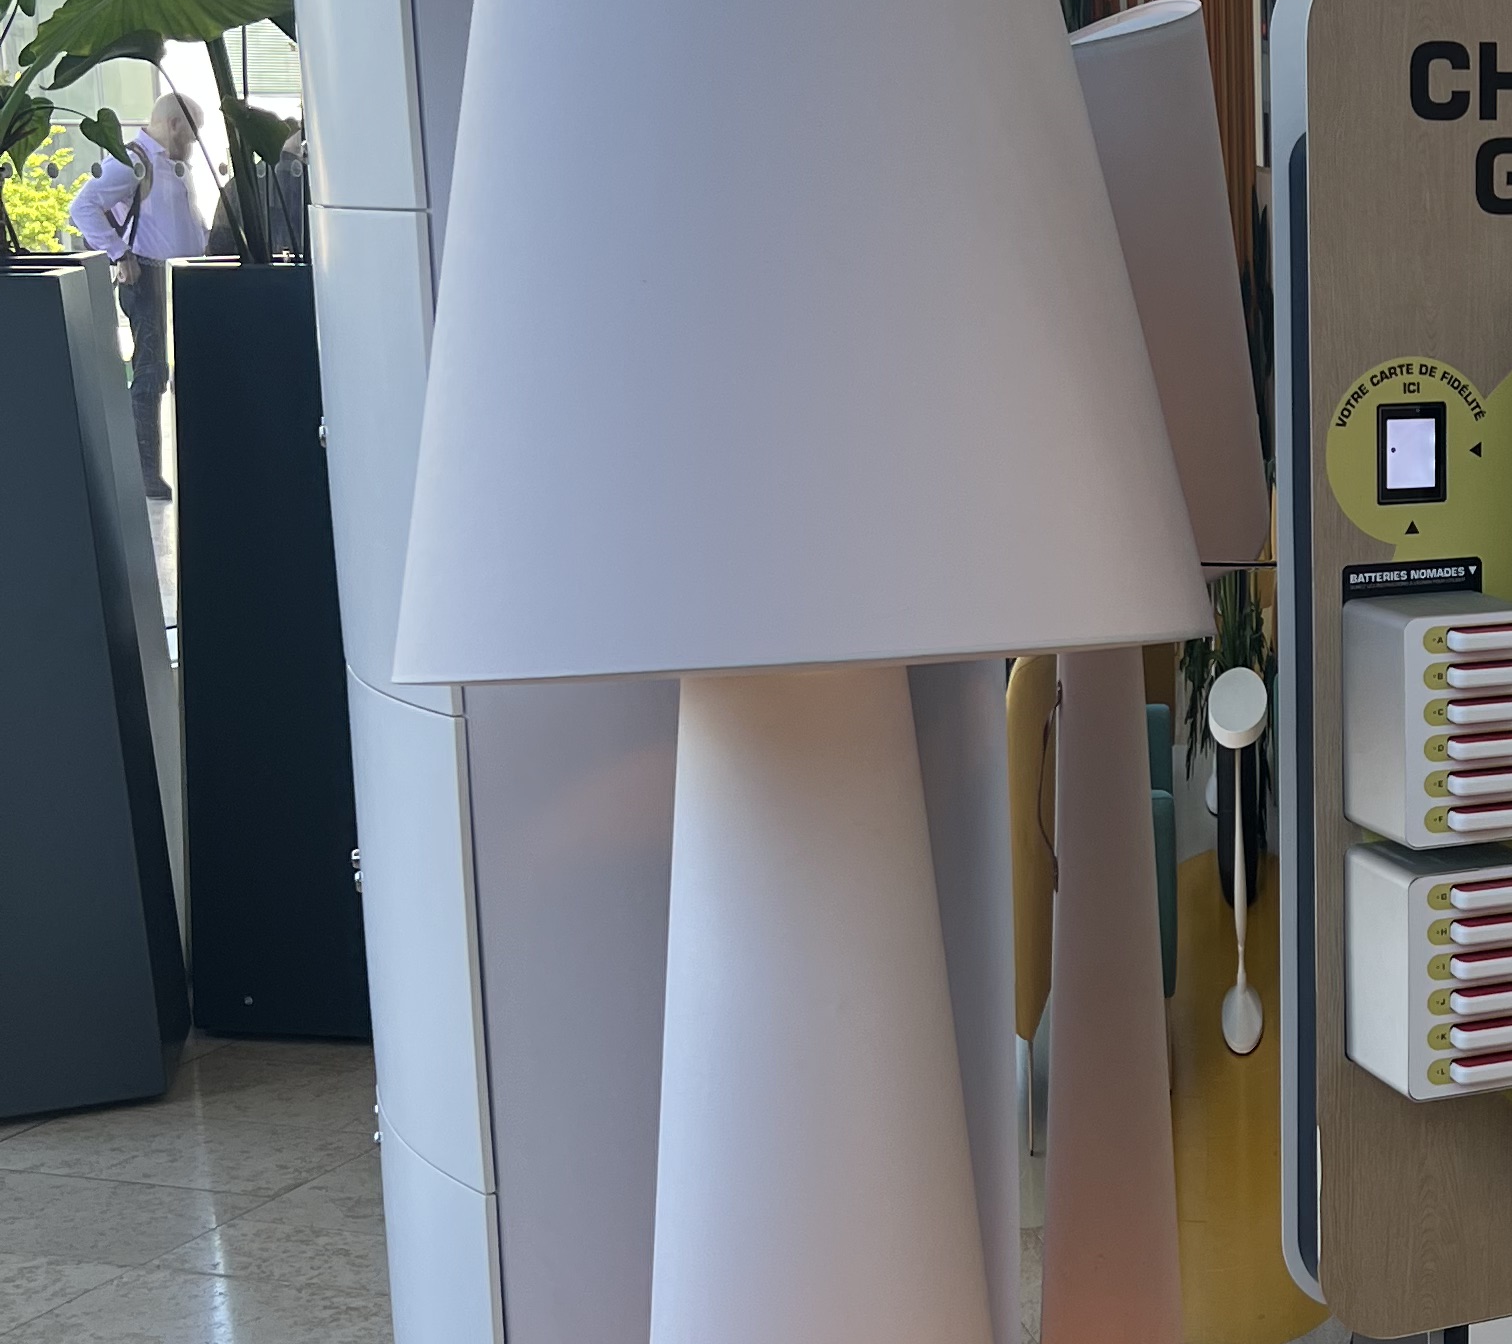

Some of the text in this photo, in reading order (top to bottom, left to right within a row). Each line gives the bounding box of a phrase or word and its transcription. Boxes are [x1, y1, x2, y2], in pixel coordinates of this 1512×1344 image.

[1335, 363, 1487, 428] VOTRE CARTE DE FIDÉLITÉ
[1403, 382, 1421, 395] ICI
[1349, 570, 1408, 584] BATTERIES
[1410, 566, 1466, 580] NOMADES
